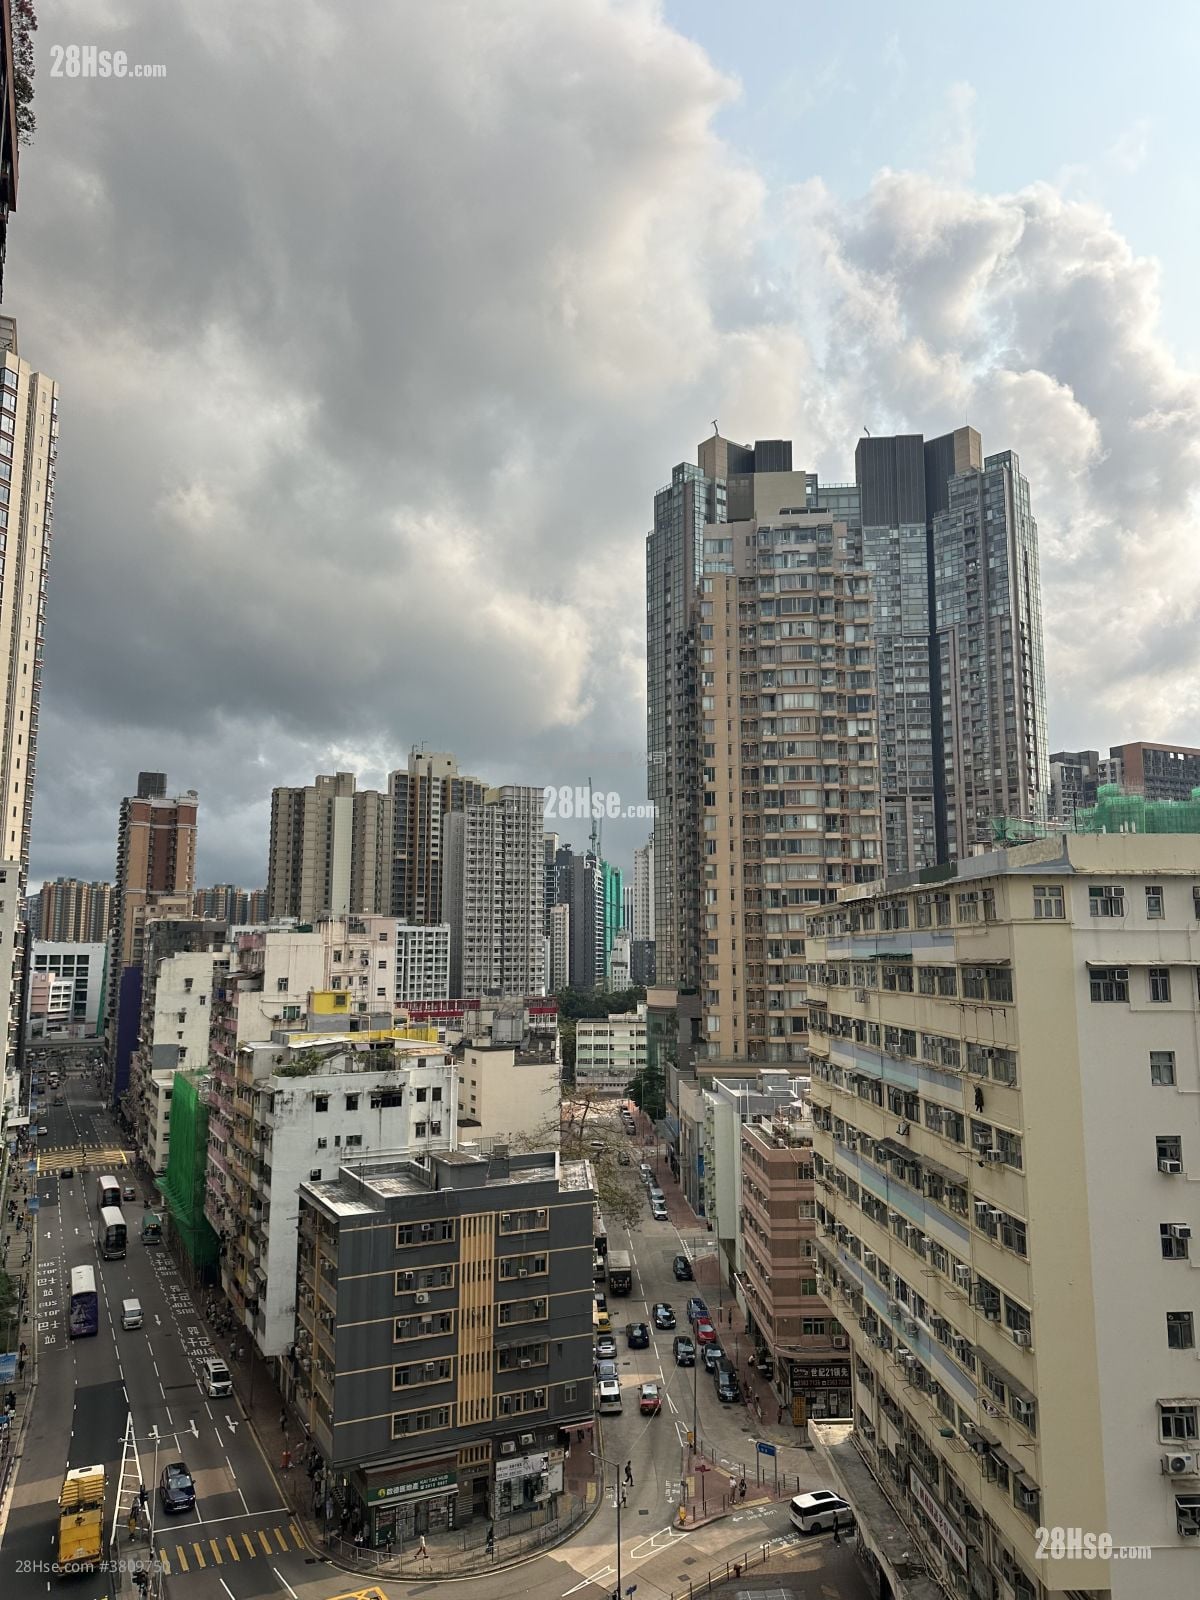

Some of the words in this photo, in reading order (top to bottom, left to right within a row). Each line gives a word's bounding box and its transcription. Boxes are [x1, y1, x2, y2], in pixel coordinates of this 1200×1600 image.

[38, 1277, 58, 1286] 巴士
[36, 1310, 60, 1318] STOP
[38, 1320, 60, 1332] 巴士
[44, 1334, 56, 1344] 站
[187, 1336, 211, 1348] 巴士
